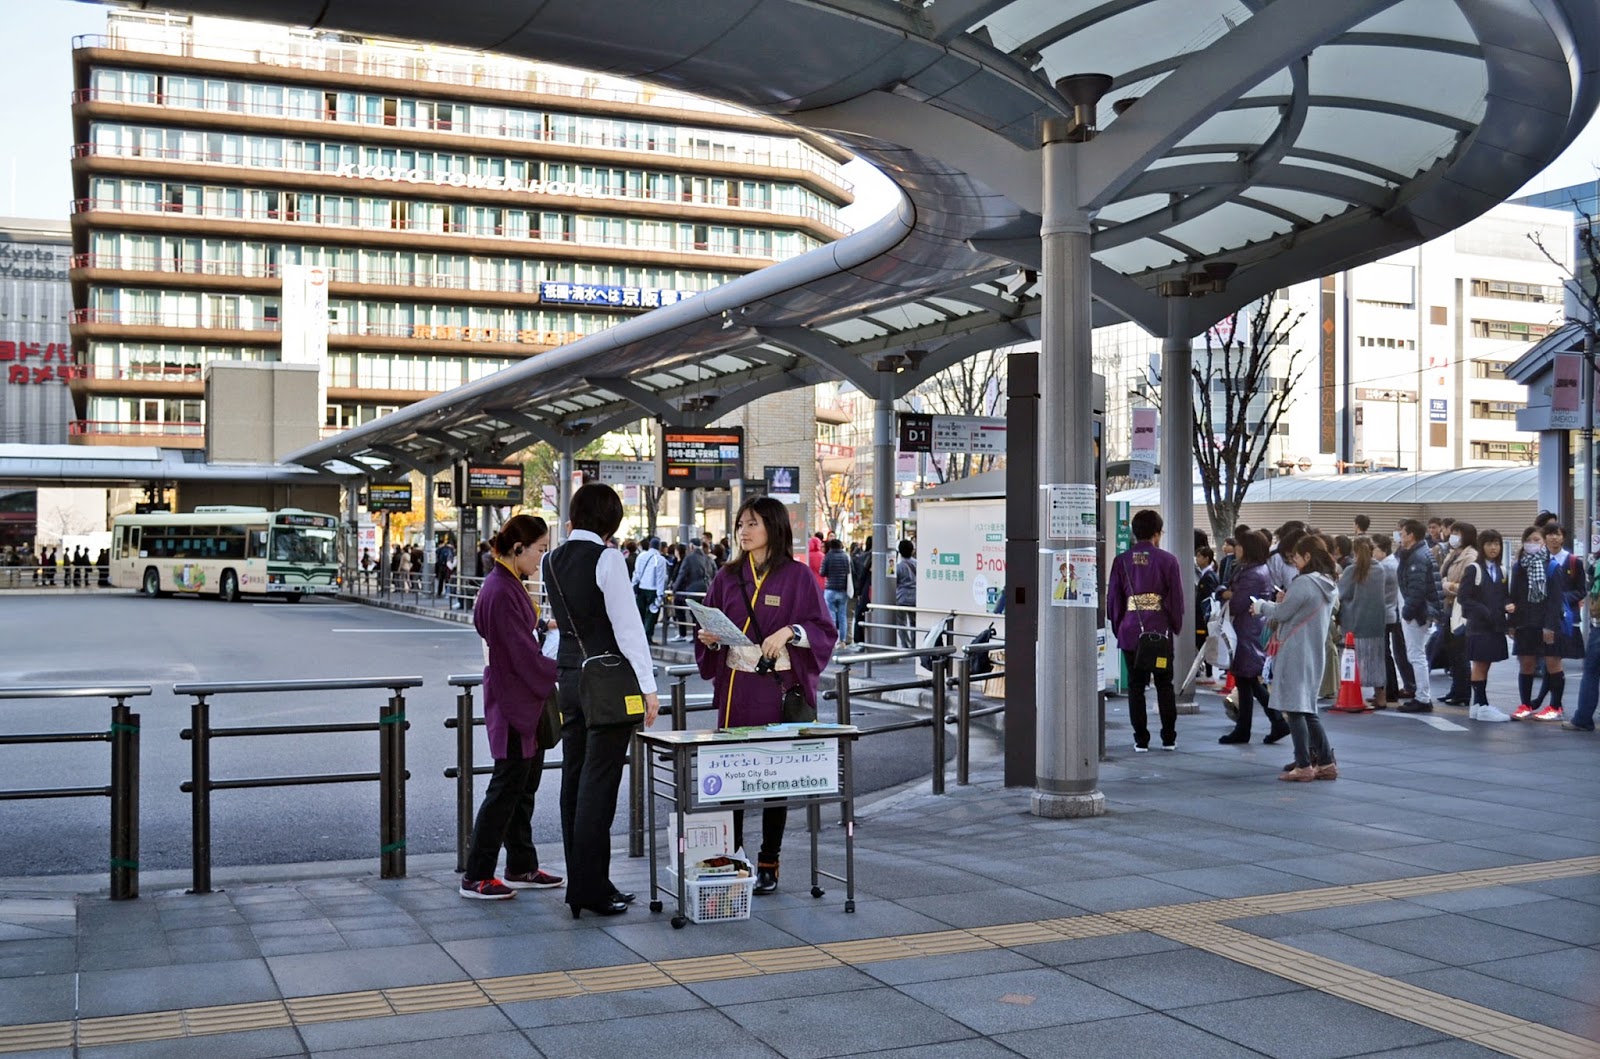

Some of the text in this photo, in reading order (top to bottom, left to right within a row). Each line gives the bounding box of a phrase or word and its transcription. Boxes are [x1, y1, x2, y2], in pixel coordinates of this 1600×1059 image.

[334, 163, 607, 200] KYOTO TOWER HOTEL
[908, 430, 926, 442] D1
[708, 753, 828, 769] おもてなし コンシェルジュ
[725, 769, 777, 780] Kyoto City Bus
[741, 775, 828, 793] Information
